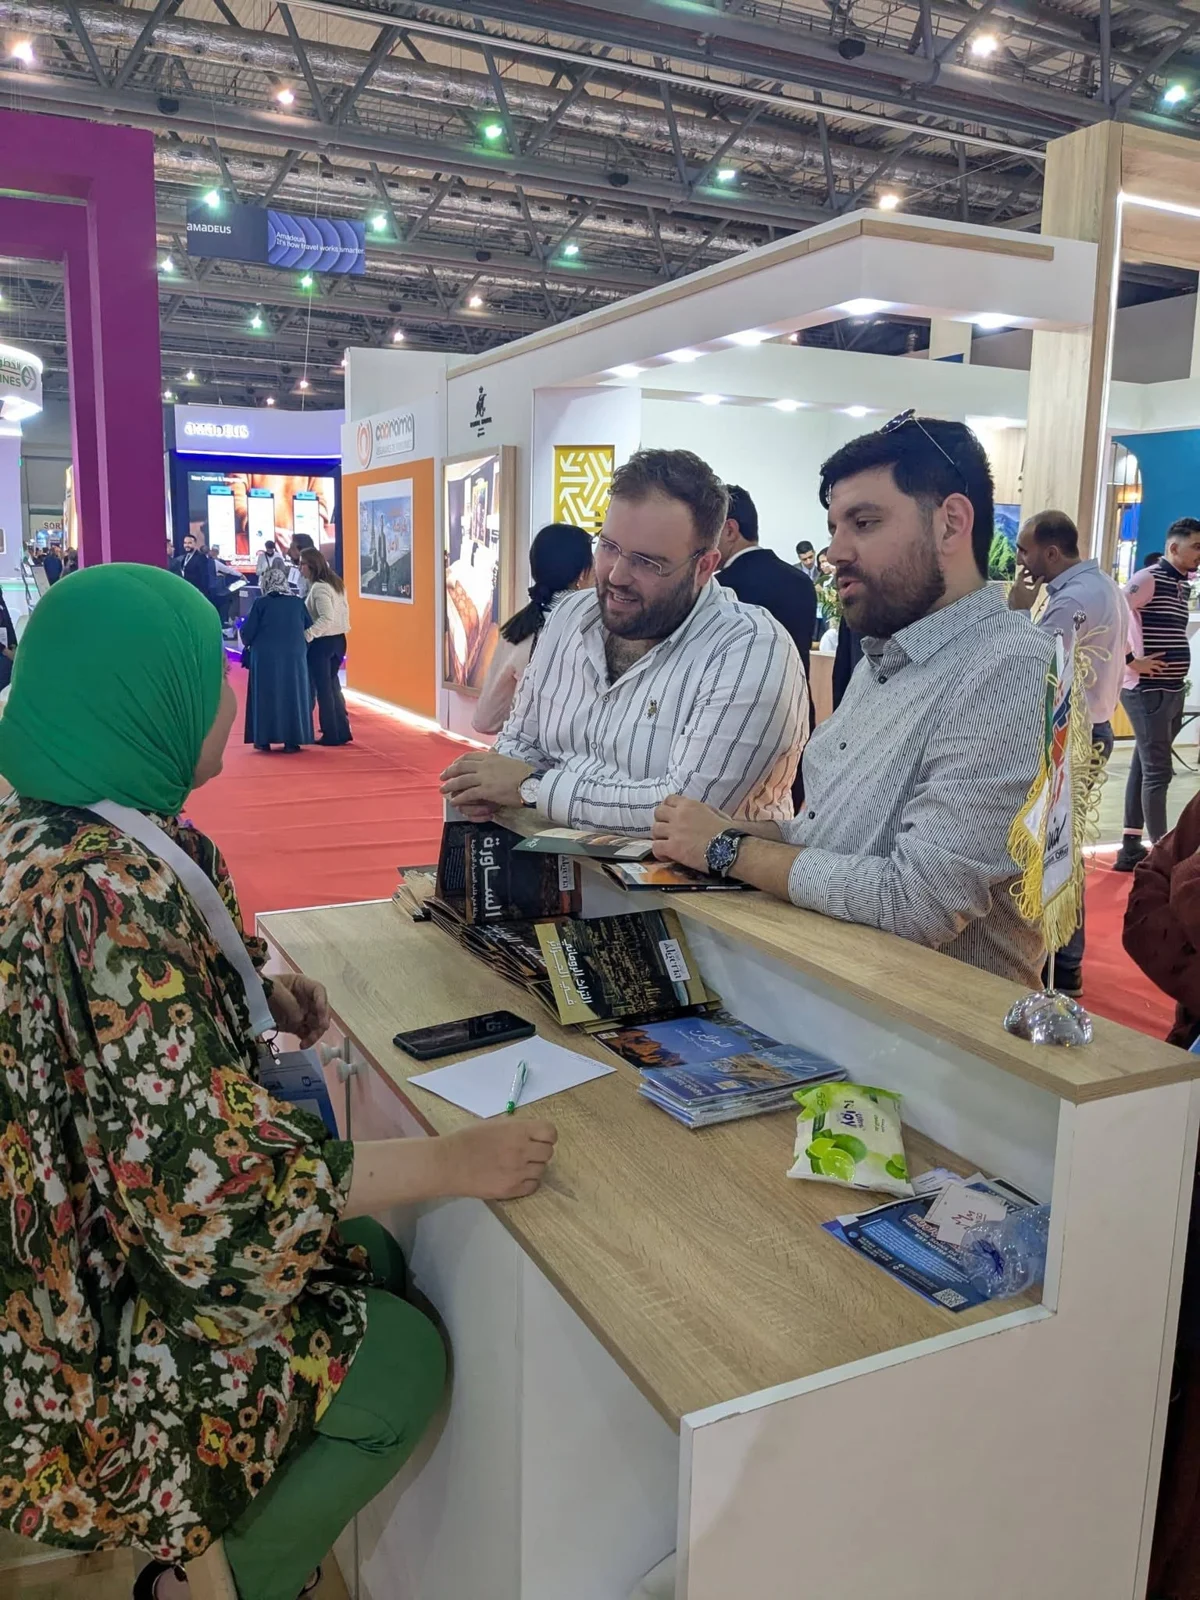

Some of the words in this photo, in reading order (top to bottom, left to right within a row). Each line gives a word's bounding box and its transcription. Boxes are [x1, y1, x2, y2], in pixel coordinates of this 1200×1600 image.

[287, 241, 300, 249] how
[301, 243, 319, 251] travel
[663, 942, 682, 980] Algeria
